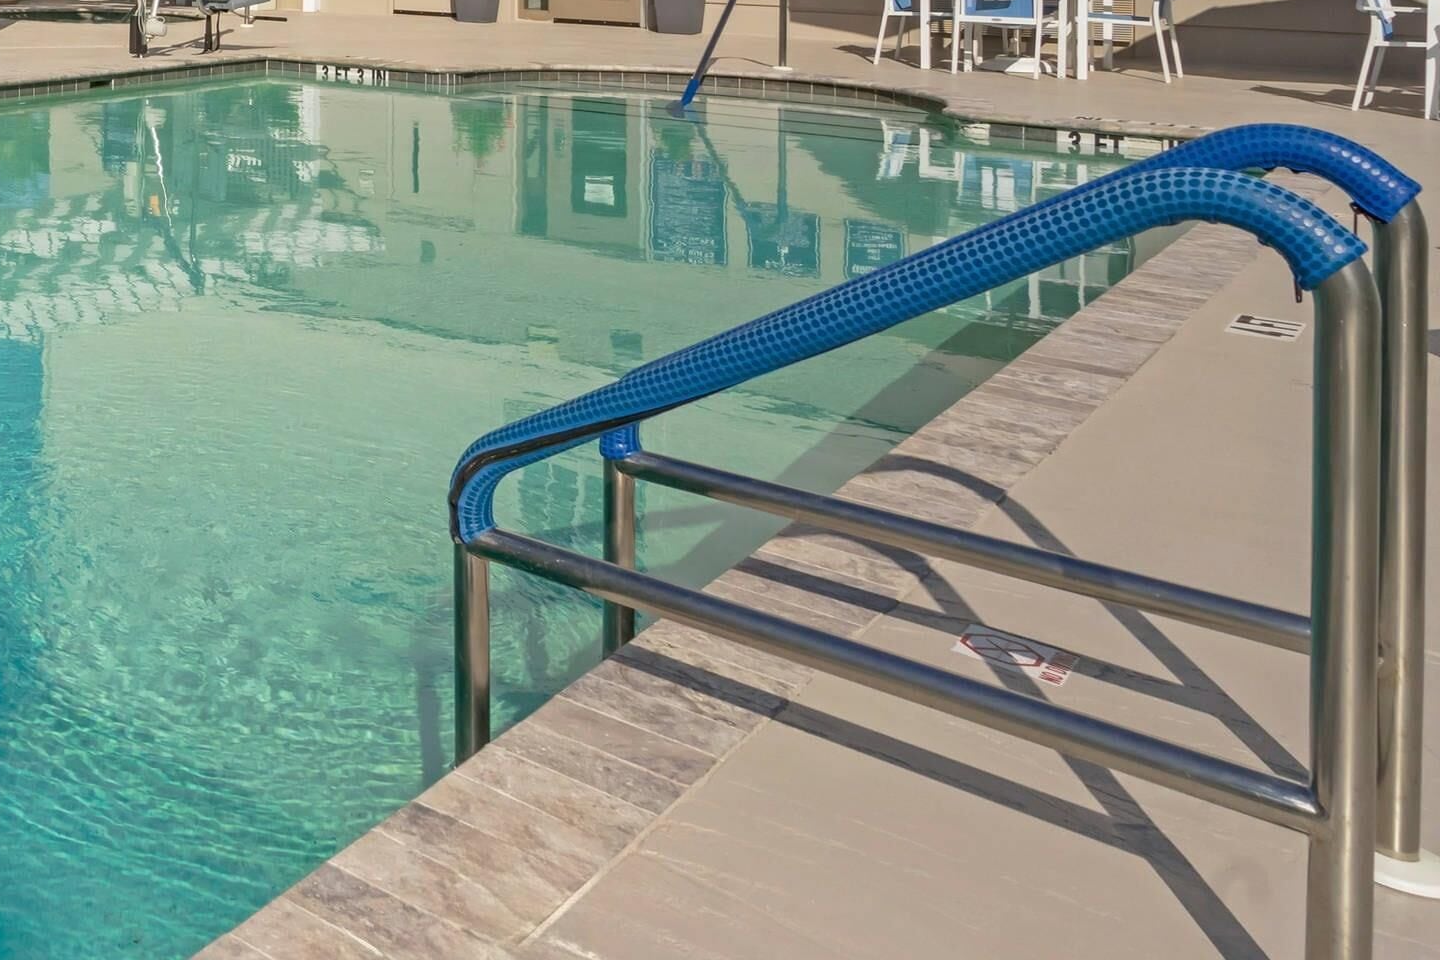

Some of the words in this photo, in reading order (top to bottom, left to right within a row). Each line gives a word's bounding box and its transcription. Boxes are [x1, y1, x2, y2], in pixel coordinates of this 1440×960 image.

[322, 64, 329, 80] 3
[335, 66, 351, 79] FT
[372, 69, 386, 82] IN
[1068, 130, 1081, 148] 3
[1094, 133, 1125, 149] FT
